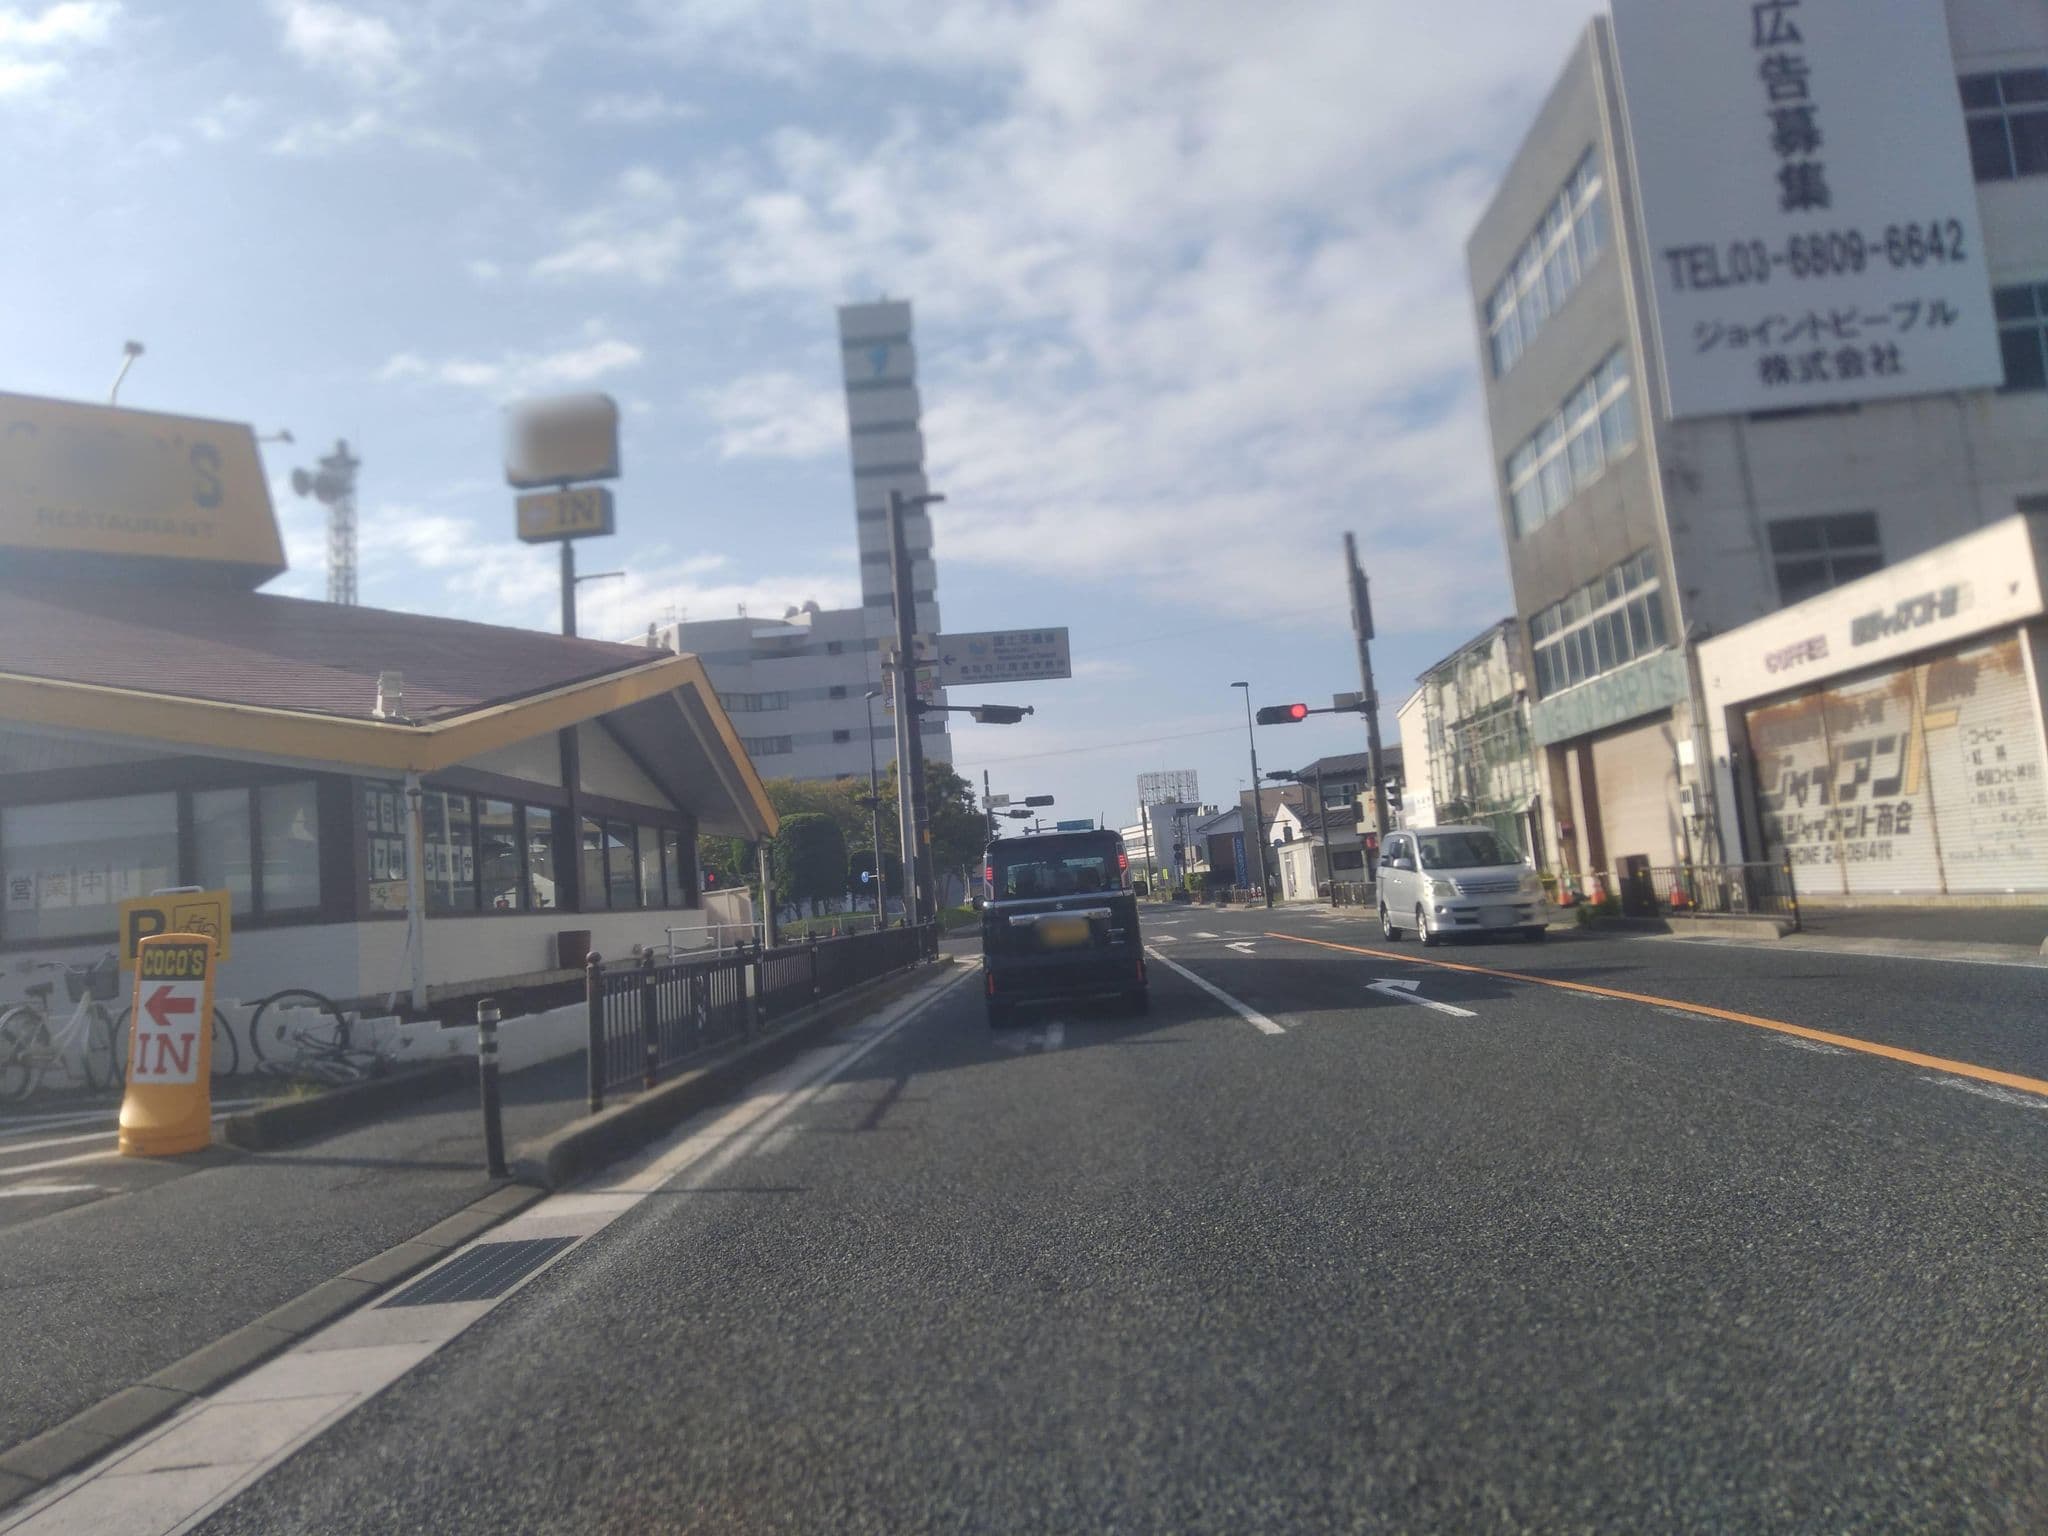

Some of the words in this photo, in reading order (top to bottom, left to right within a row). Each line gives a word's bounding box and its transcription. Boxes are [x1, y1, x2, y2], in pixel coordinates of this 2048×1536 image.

[1751, 0, 1833, 212] 広告募集
[1757, 341, 1905, 386] 株式会社
[558, 491, 599, 526] IN
[129, 909, 167, 959] P
[143, 949, 205, 976] COCO'S
[136, 1033, 196, 1075] IN
